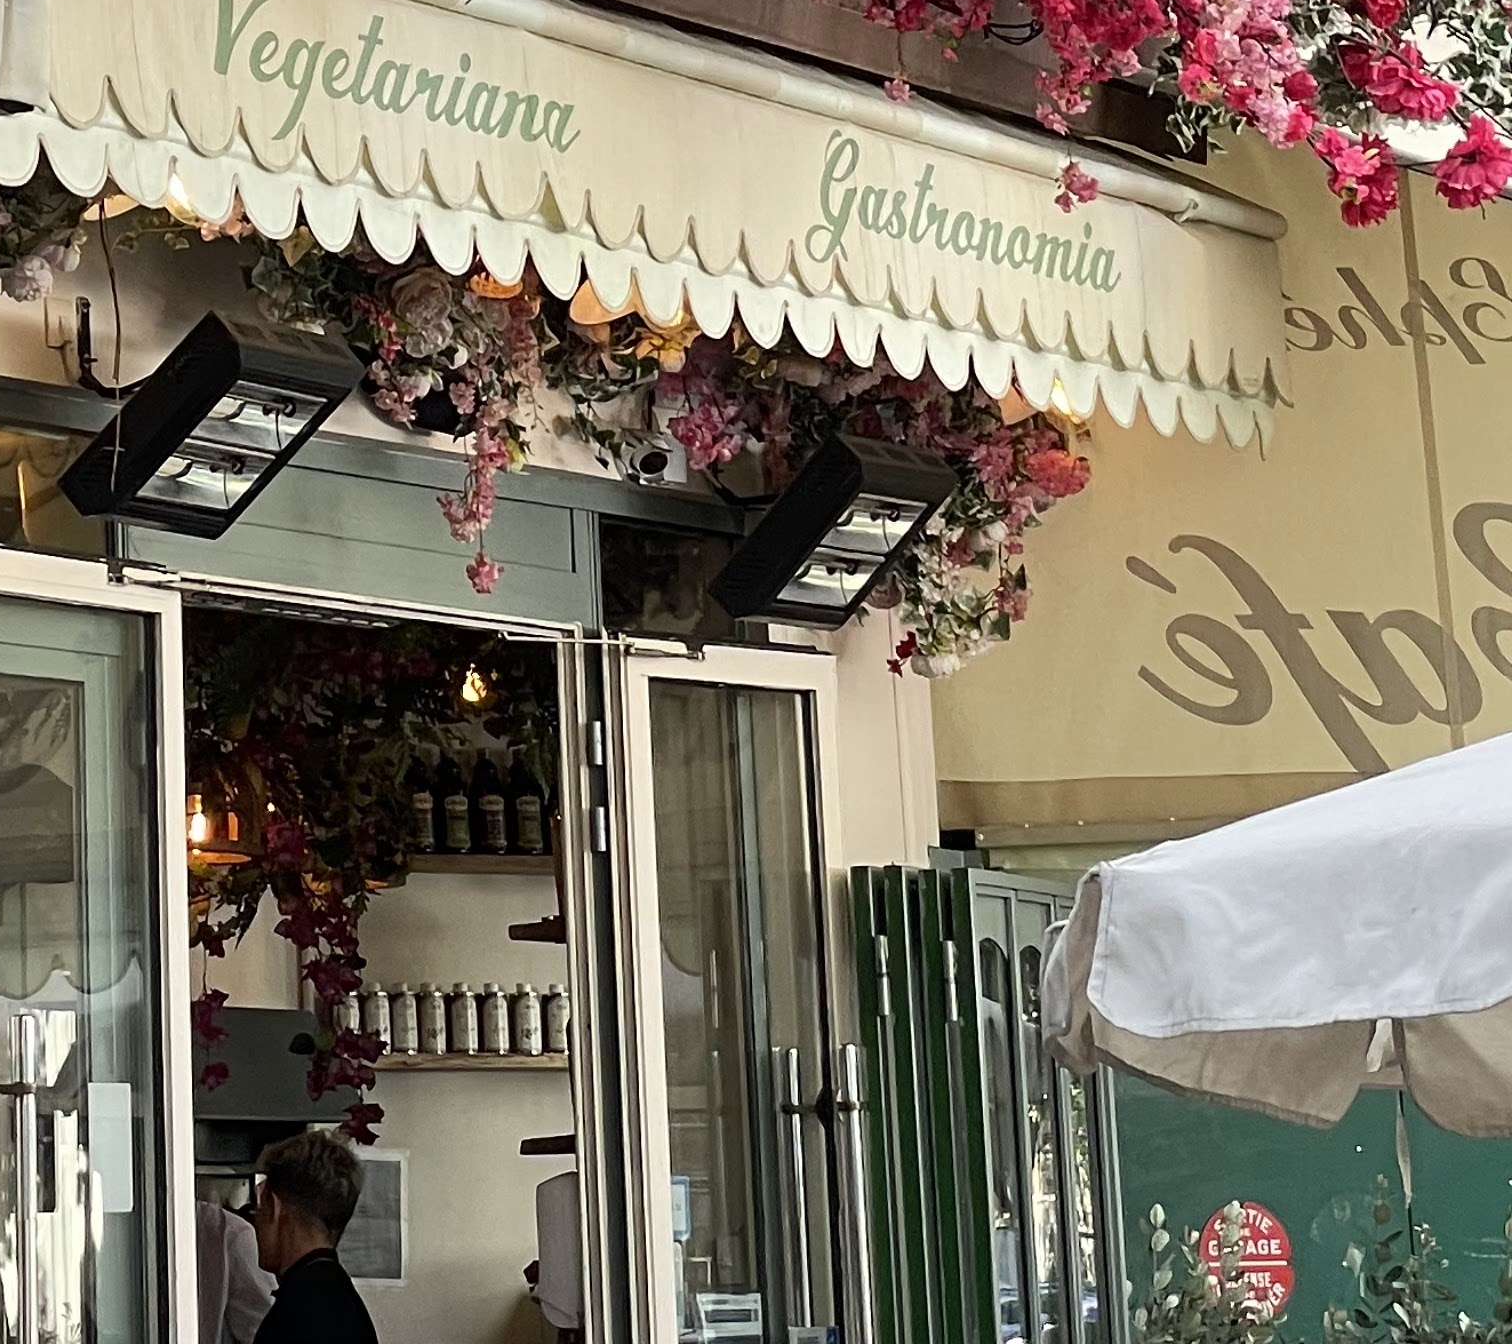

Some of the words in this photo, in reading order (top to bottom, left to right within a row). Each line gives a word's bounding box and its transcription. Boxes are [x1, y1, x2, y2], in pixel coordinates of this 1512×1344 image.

[804, 128, 1122, 293] Gastronomia
[1213, 1207, 1273, 1235] SRTIE
[1208, 1239, 1283, 1256] GAGE
[1225, 1271, 1273, 1289] ENSE
